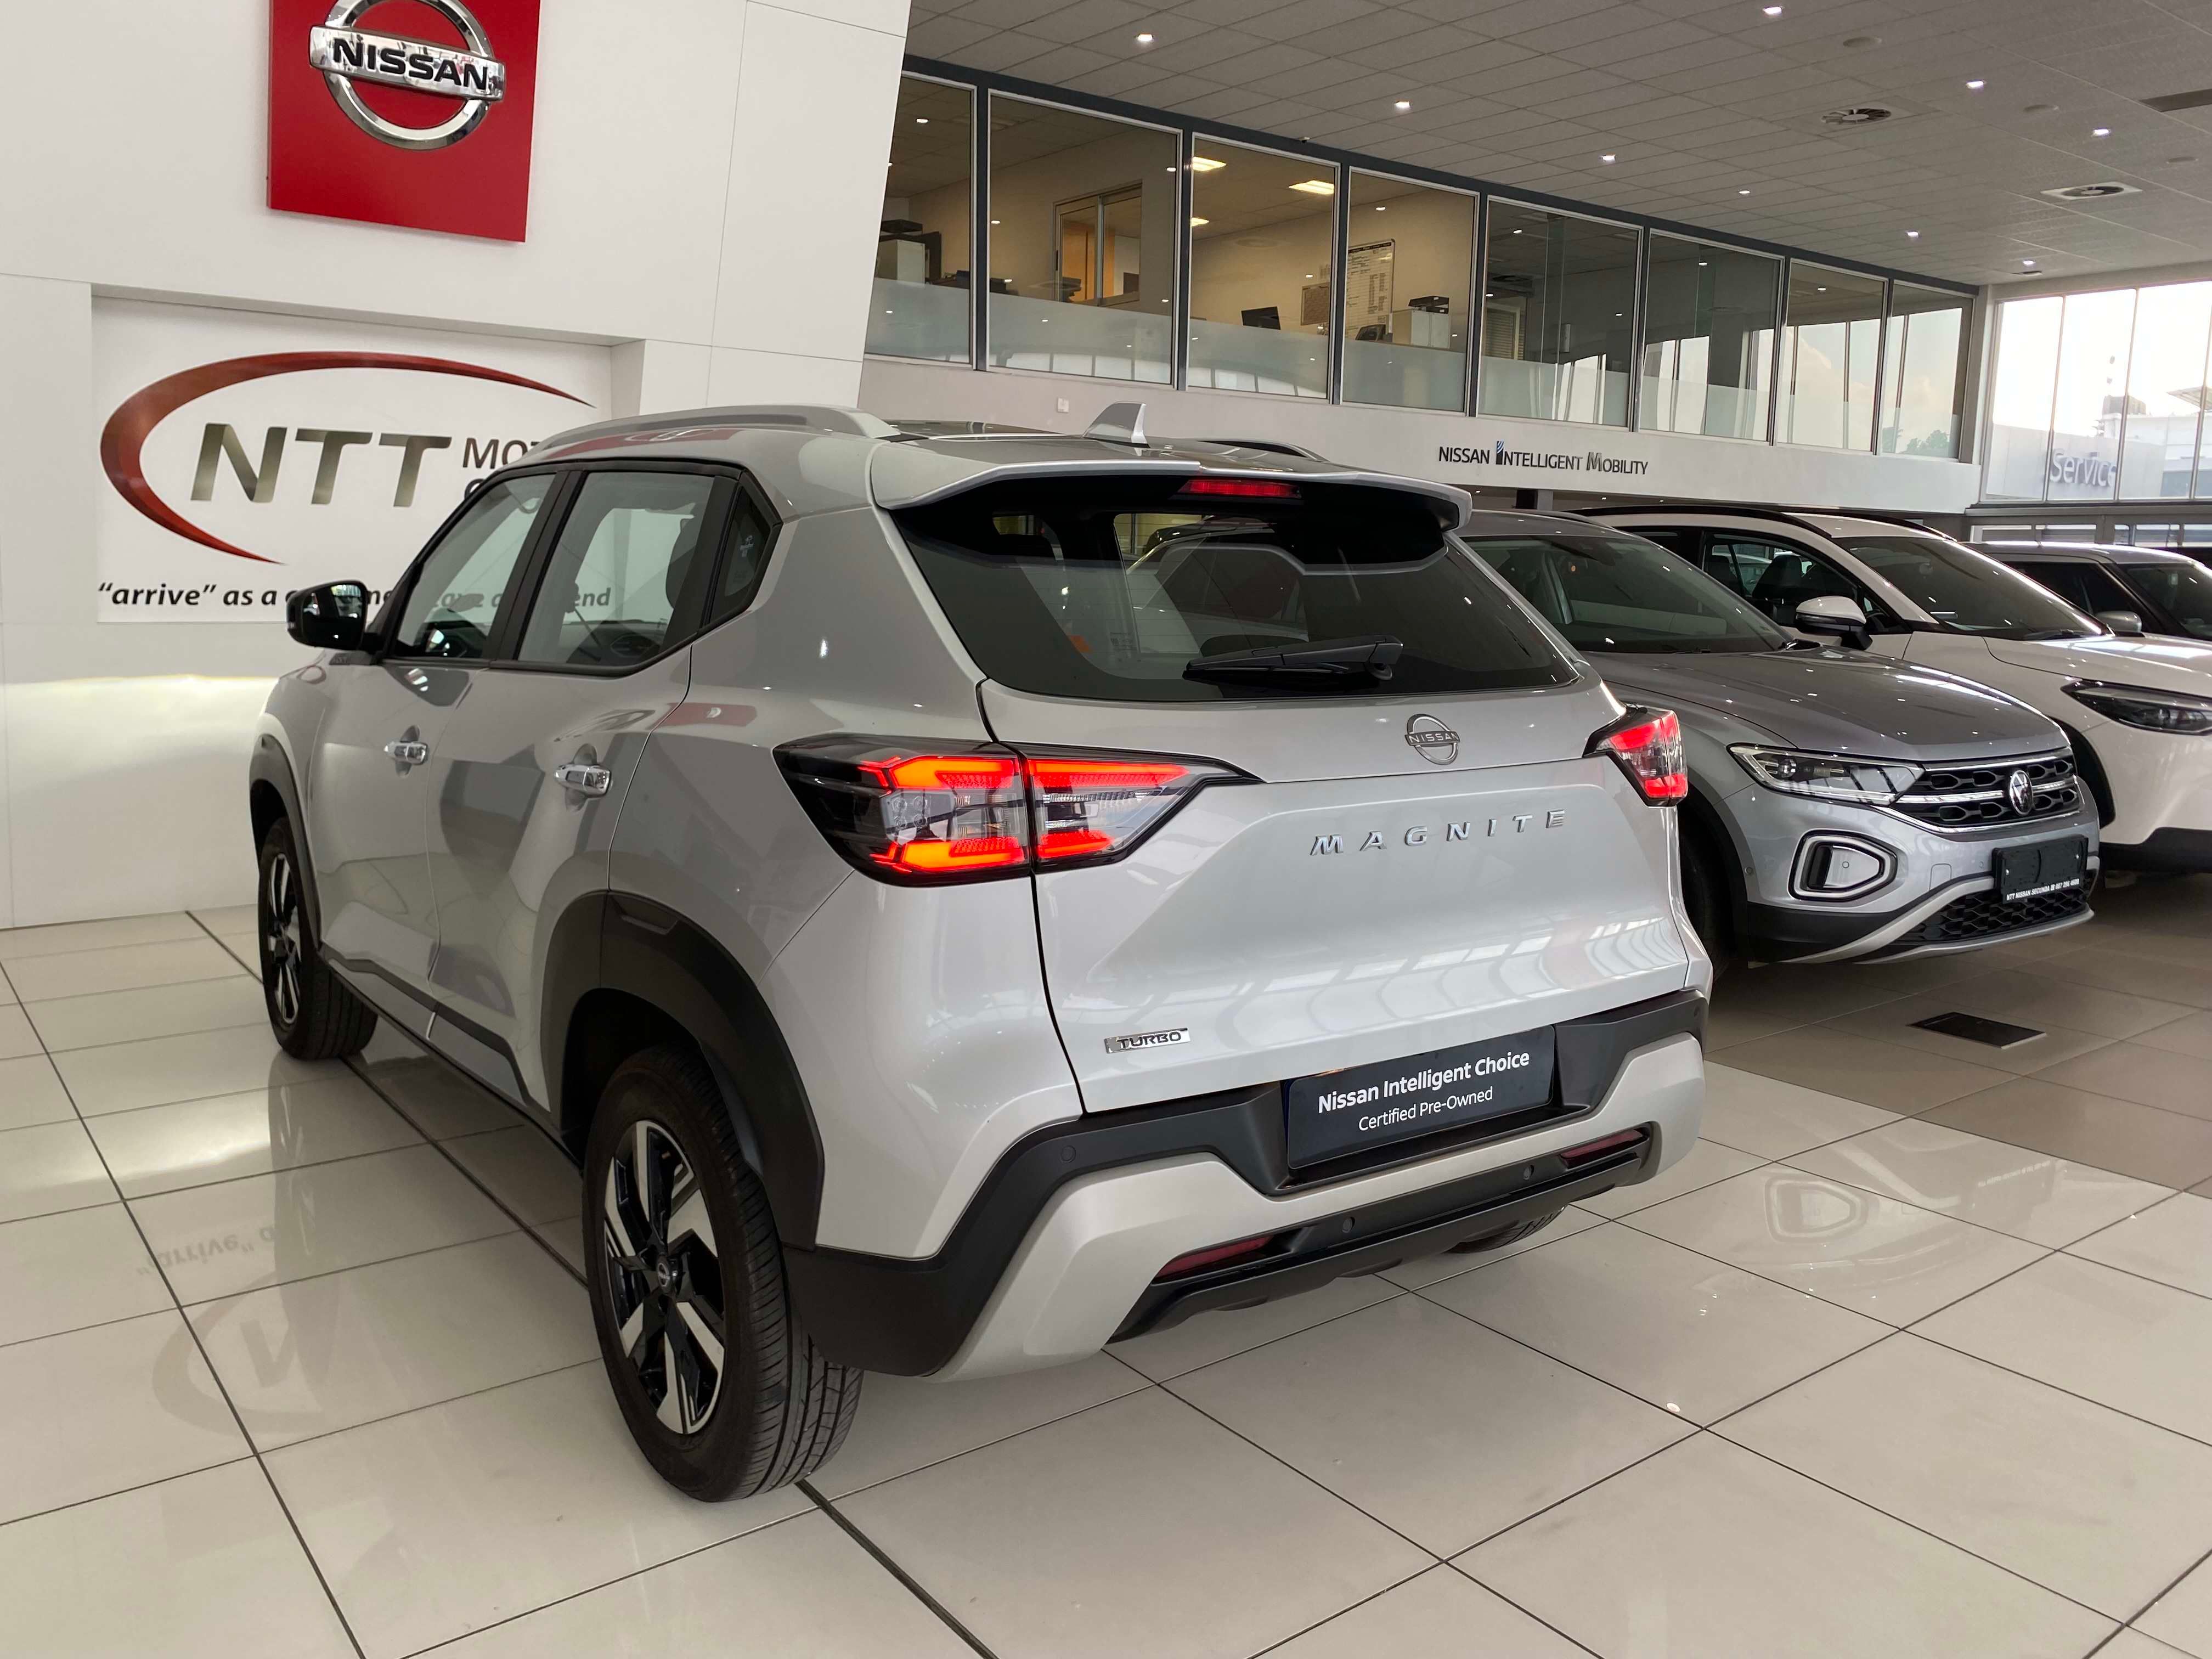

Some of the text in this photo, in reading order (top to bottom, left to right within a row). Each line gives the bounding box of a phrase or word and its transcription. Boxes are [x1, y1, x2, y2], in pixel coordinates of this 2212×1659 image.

[332, 37, 488, 90] NISSAN
[190, 422, 452, 507] NTT
[1438, 439, 1649, 475] NISSAN INTELLIGENT MOBILITY
[2050, 448, 2116, 487] Service
[223, 589, 253, 605] as
[261, 589, 278, 605] a
[1408, 732, 1459, 743] NISSAN
[1310, 809, 1565, 855] MAGNITE
[2006, 893, 2015, 901] NTT
[1116, 1031, 1181, 1049] TURBO
[1317, 1051, 1530, 1114] Nissan Intelligent Choice
[1358, 1086, 1493, 1131] Certified Pre-Owned
